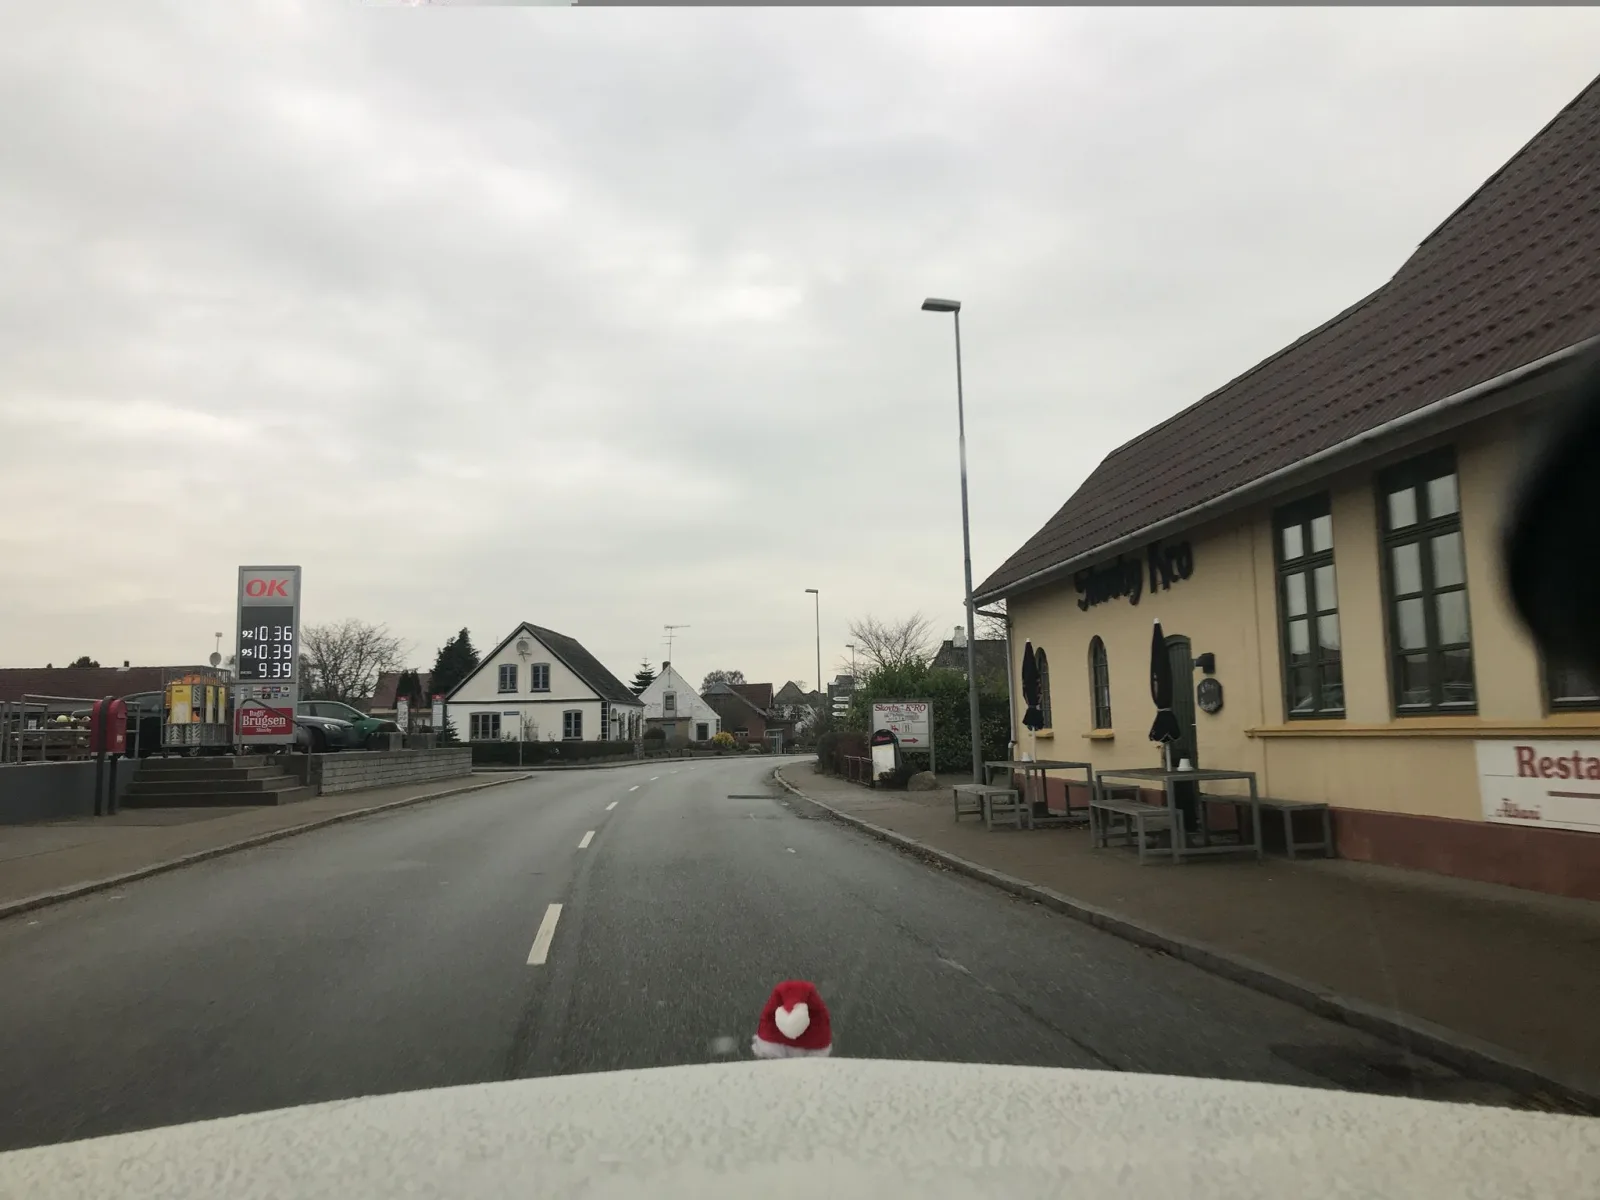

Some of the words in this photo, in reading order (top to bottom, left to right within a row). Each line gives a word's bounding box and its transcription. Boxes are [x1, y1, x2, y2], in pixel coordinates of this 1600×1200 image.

[245, 579, 289, 597] OK
[242, 630, 253, 638] 92
[254, 626, 293, 641] 10.36
[241, 649, 253, 657] 95
[253, 644, 292, 660] 10.39
[258, 662, 292, 678] 9.39
[242, 715, 286, 728] Brugsen
[1514, 746, 1600, 780] Resta
